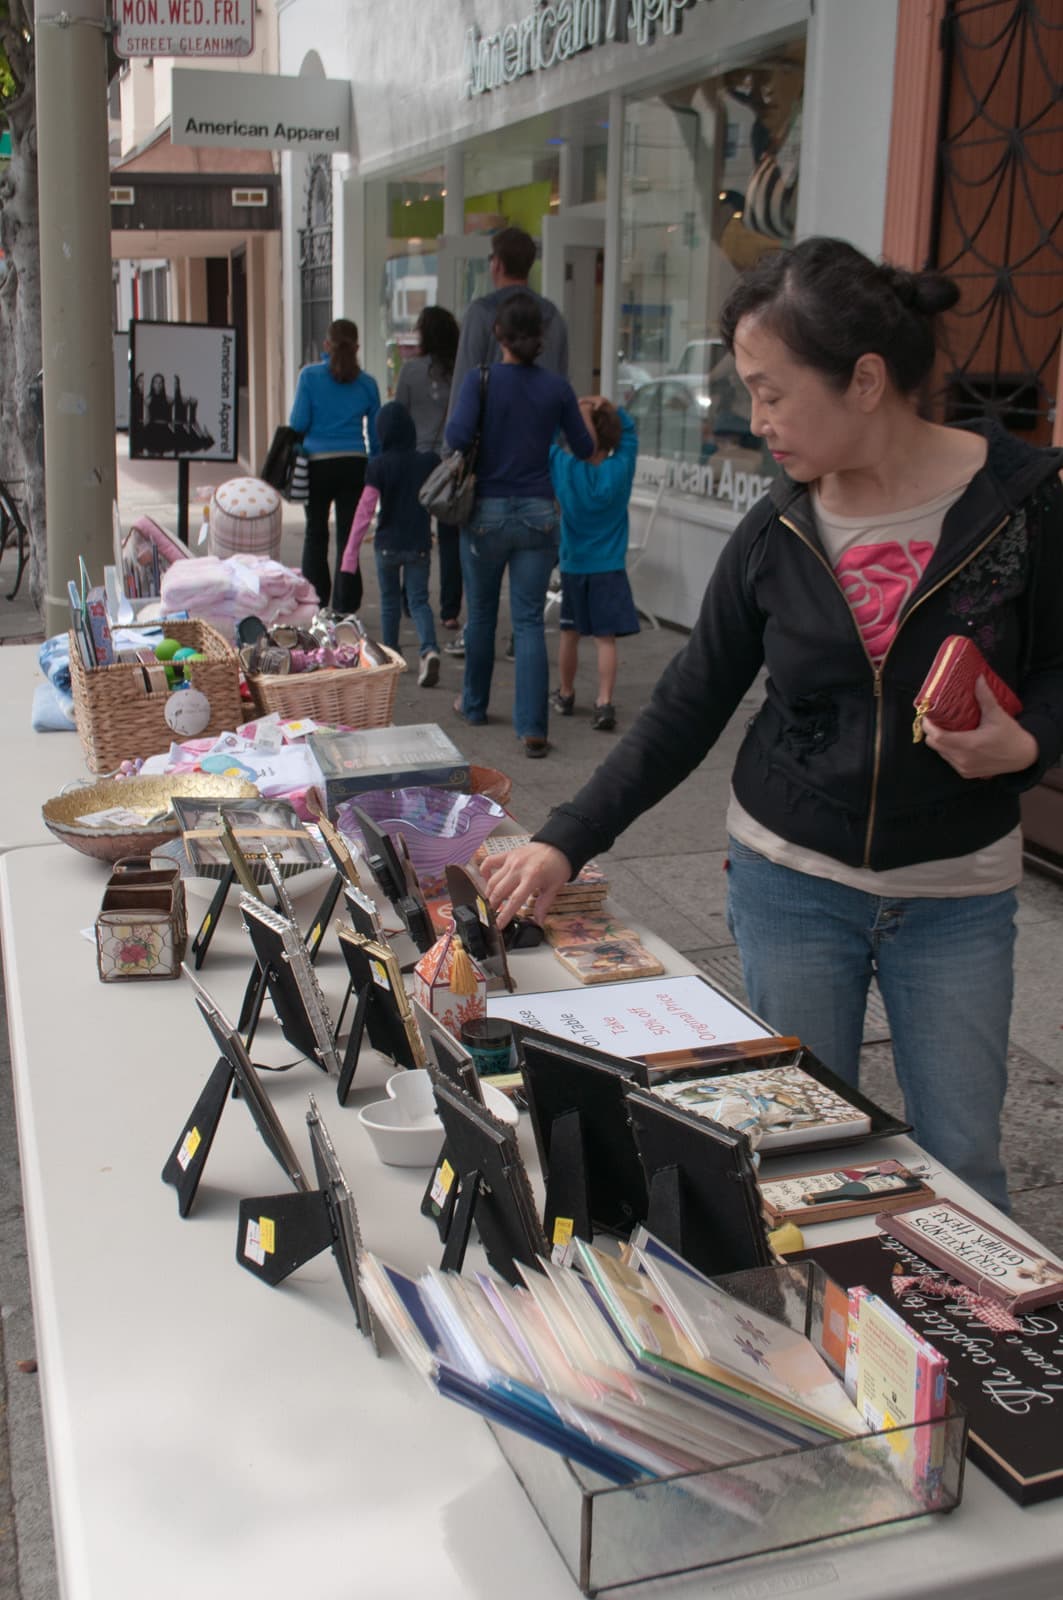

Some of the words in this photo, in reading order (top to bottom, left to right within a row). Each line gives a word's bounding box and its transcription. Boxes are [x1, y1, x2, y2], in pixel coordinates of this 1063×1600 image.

[127, 37, 172, 51] STREET
[457, 0, 600, 100] American
[185, 118, 269, 137] American
[273, 123, 340, 142] Apparel
[221, 335, 233, 399] American
[218, 402, 232, 454] Apparel
[717, 460, 774, 512] Appa
[627, 1006, 652, 1020] off
[656, 993, 681, 1016] Price
[560, 1013, 584, 1035] Table
[603, 1016, 629, 1036] Take
[640, 1014, 672, 1036] 50%
[675, 1010, 717, 1041] Original
[914, 1217, 1007, 1277] GIRLFRIENDS
[970, 1233, 1024, 1267] GATHER
[914, 1309, 996, 1365] simplest
[982, 1363, 1053, 1415] The
